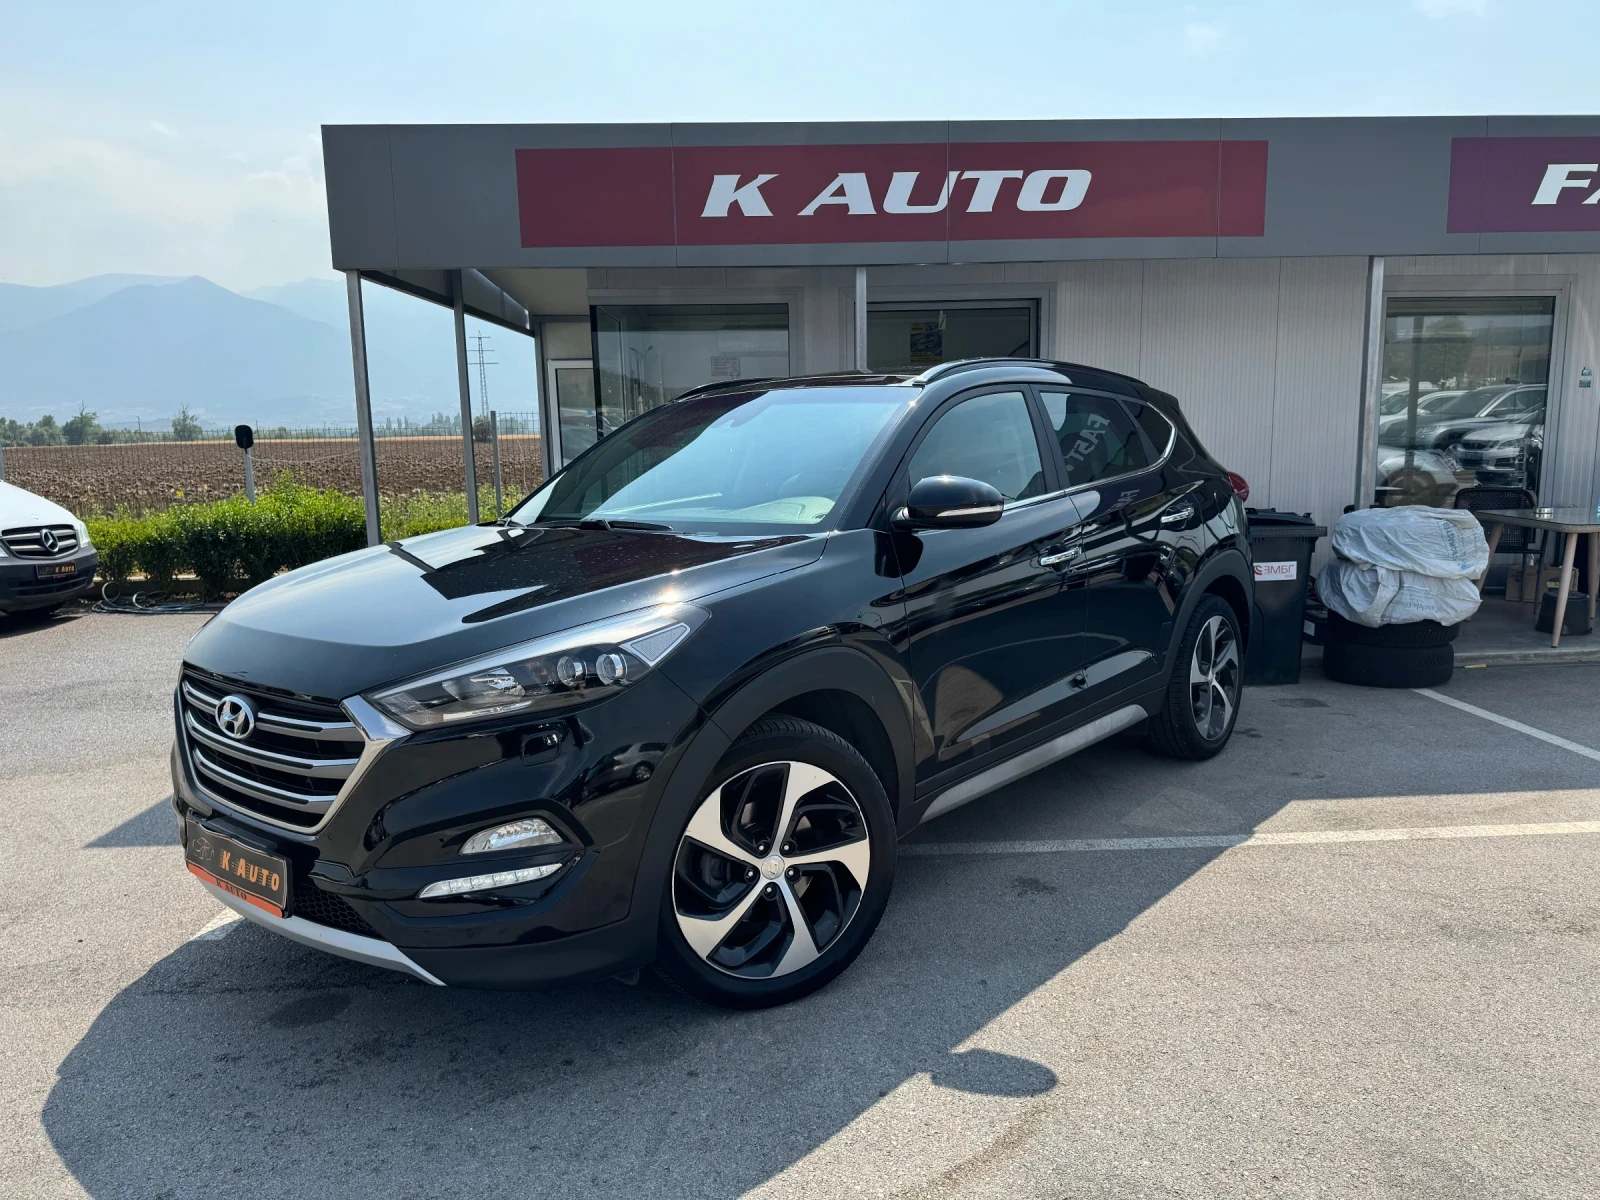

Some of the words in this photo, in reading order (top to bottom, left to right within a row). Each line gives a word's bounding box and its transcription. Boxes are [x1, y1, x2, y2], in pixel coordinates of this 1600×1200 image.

[700, 173, 780, 218] K
[797, 168, 1093, 216] AUTO
[1264, 565, 1295, 574] ЗМБГ
[221, 850, 231, 872] K
[236, 857, 280, 891] AUTO
[216, 878, 222, 888] K
[224, 883, 247, 901] AUTO
